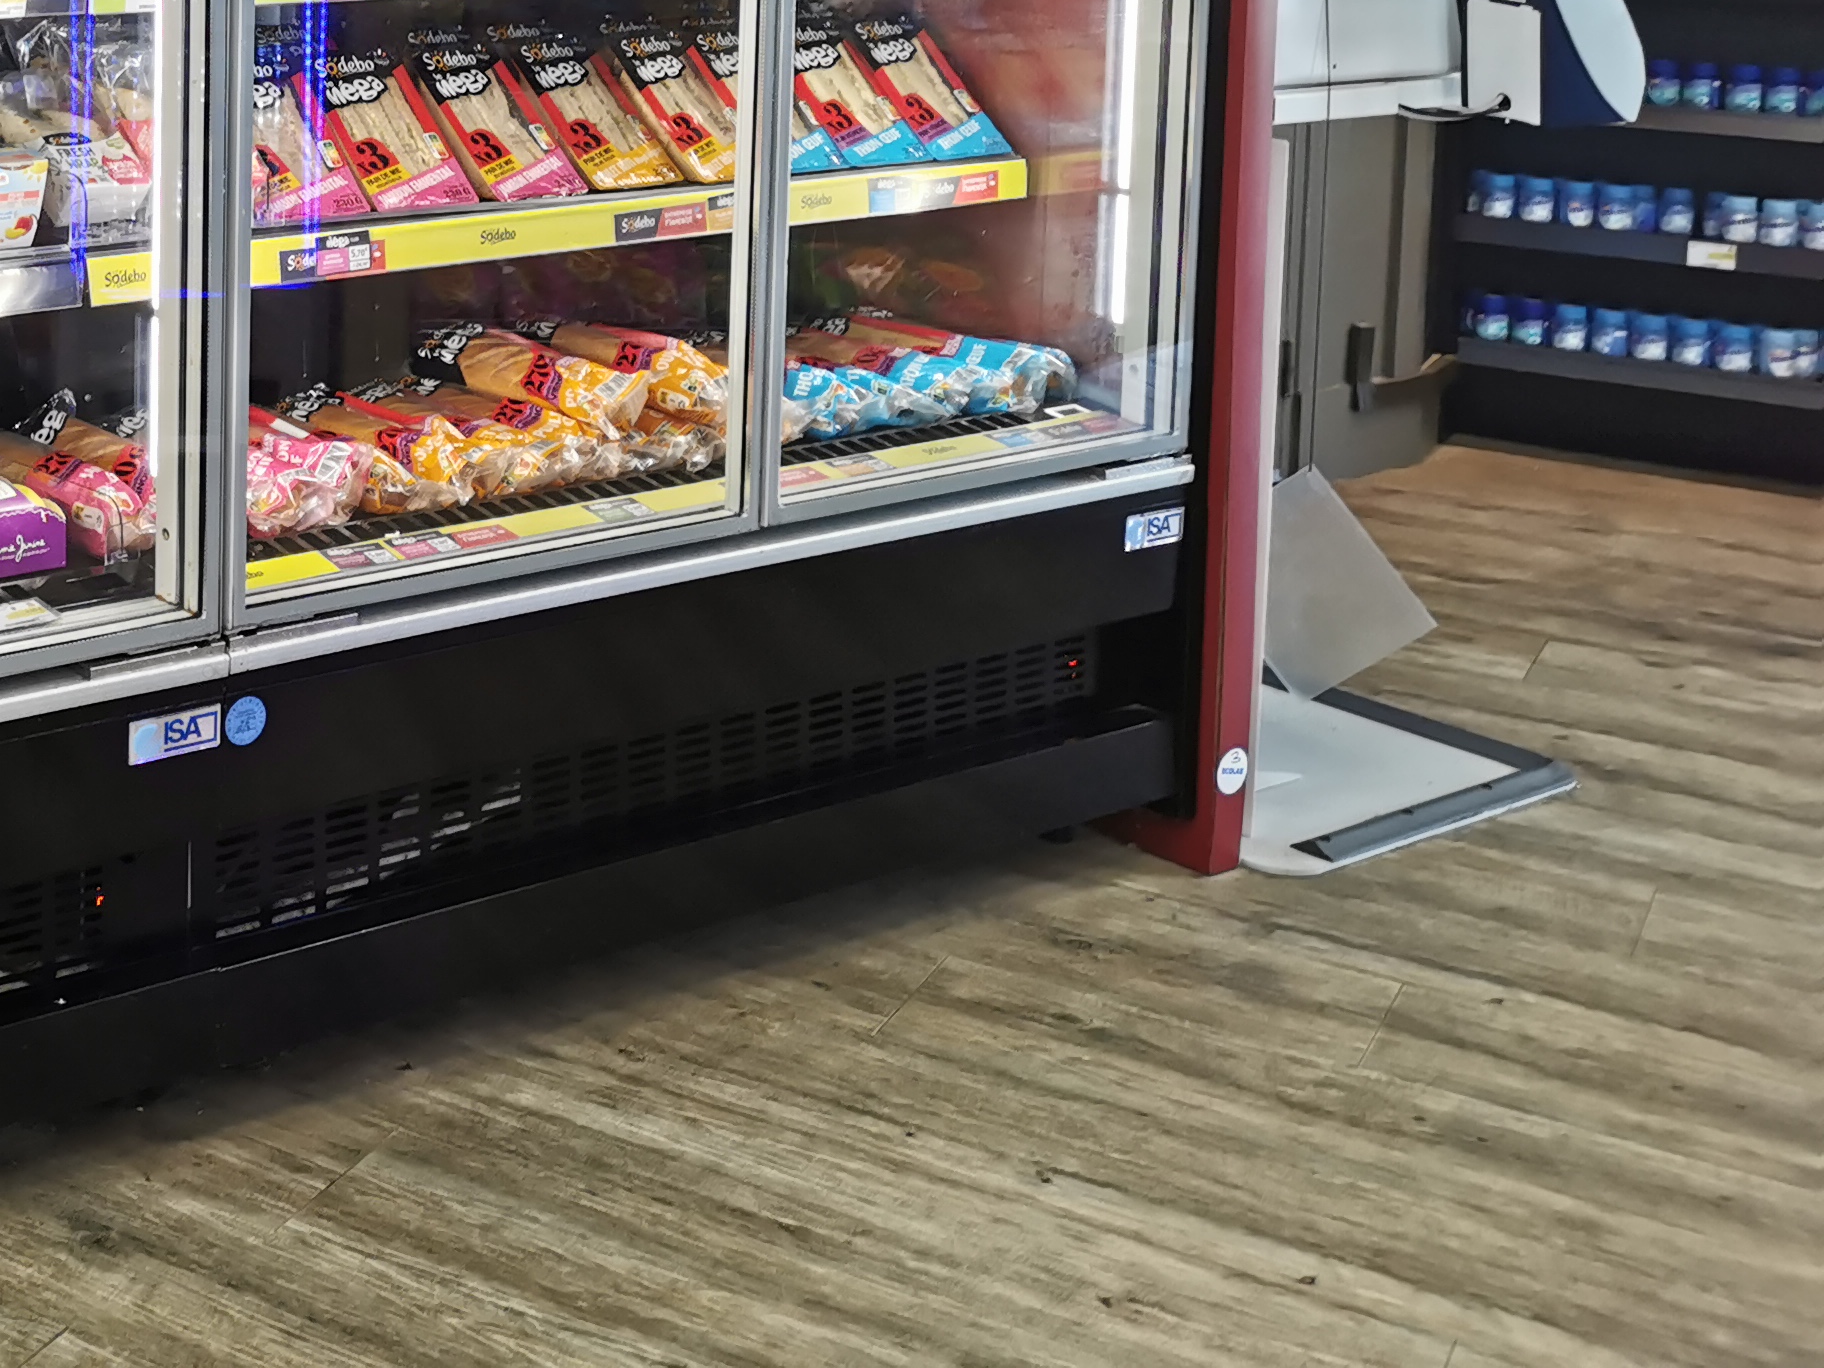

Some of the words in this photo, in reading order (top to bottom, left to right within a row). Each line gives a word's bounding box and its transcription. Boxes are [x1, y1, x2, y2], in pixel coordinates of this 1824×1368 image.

[620, 36, 671, 58] Sodebo
[422, 50, 477, 72] Sodebo
[854, 139, 882, 158] THON
[1146, 515, 1172, 538] ISA
[15, 533, 47, 563] Janine
[163, 716, 202, 746] ISA
[1230, 750, 1242, 764] 3
